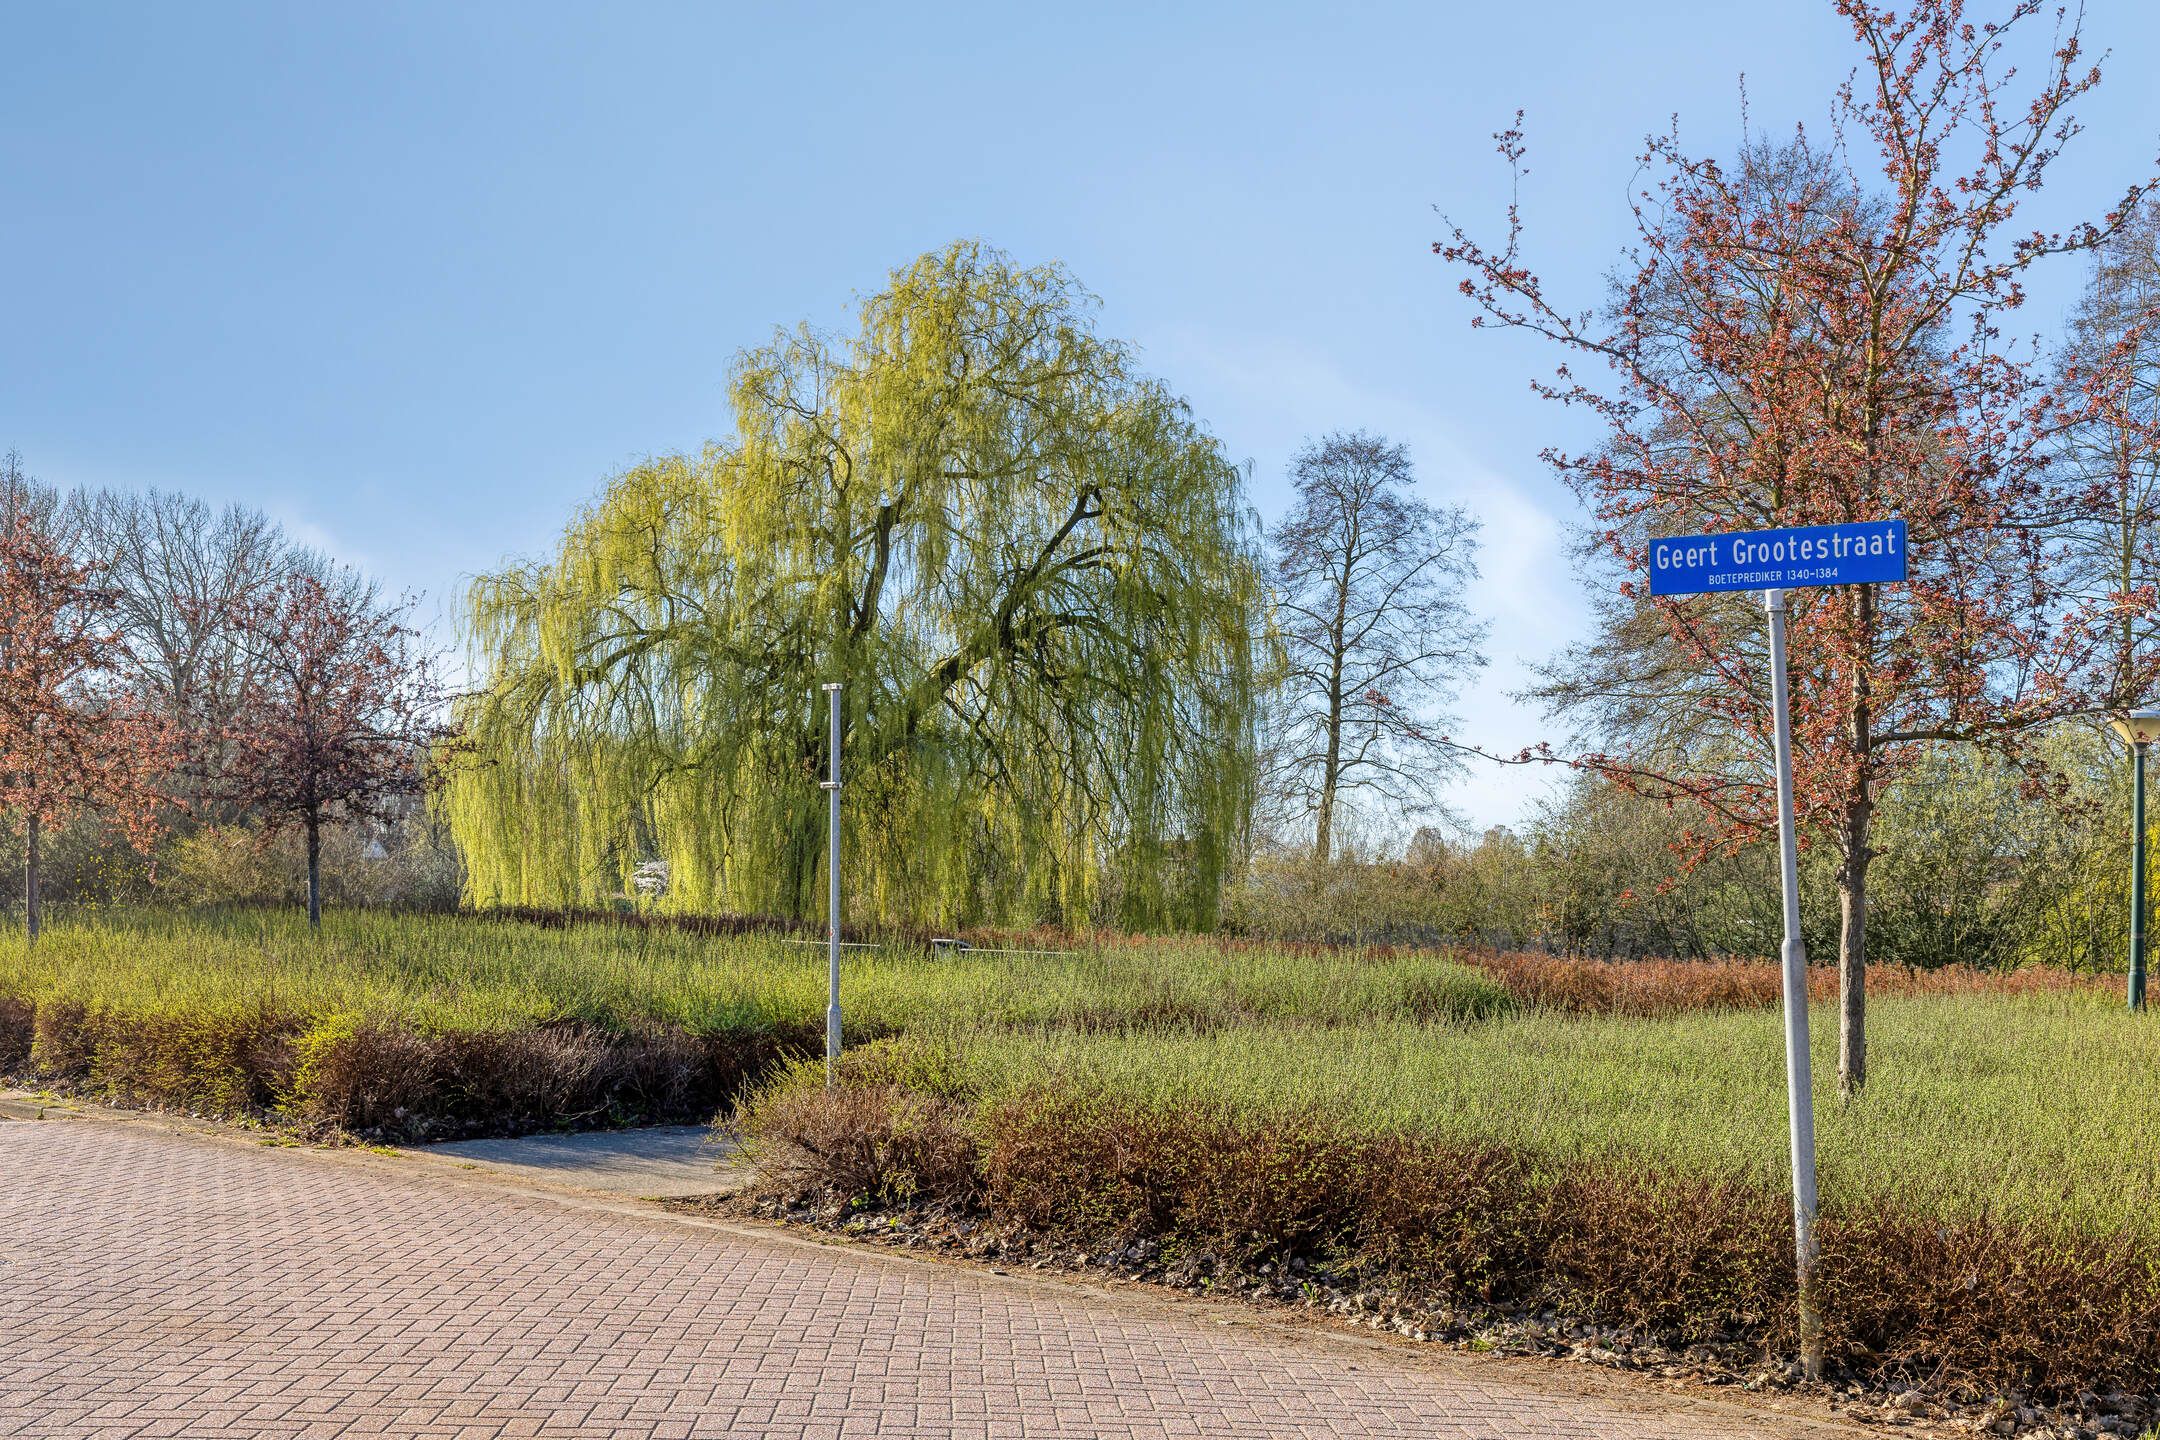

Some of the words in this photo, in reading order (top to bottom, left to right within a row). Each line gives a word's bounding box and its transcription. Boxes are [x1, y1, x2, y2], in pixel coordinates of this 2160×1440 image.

[1656, 541, 1718, 570] Geert
[1733, 528, 1896, 565] Grootestraat
[1708, 571, 1782, 585] BOETEPREDIKER
[1787, 567, 1839, 580] 1340-1384
